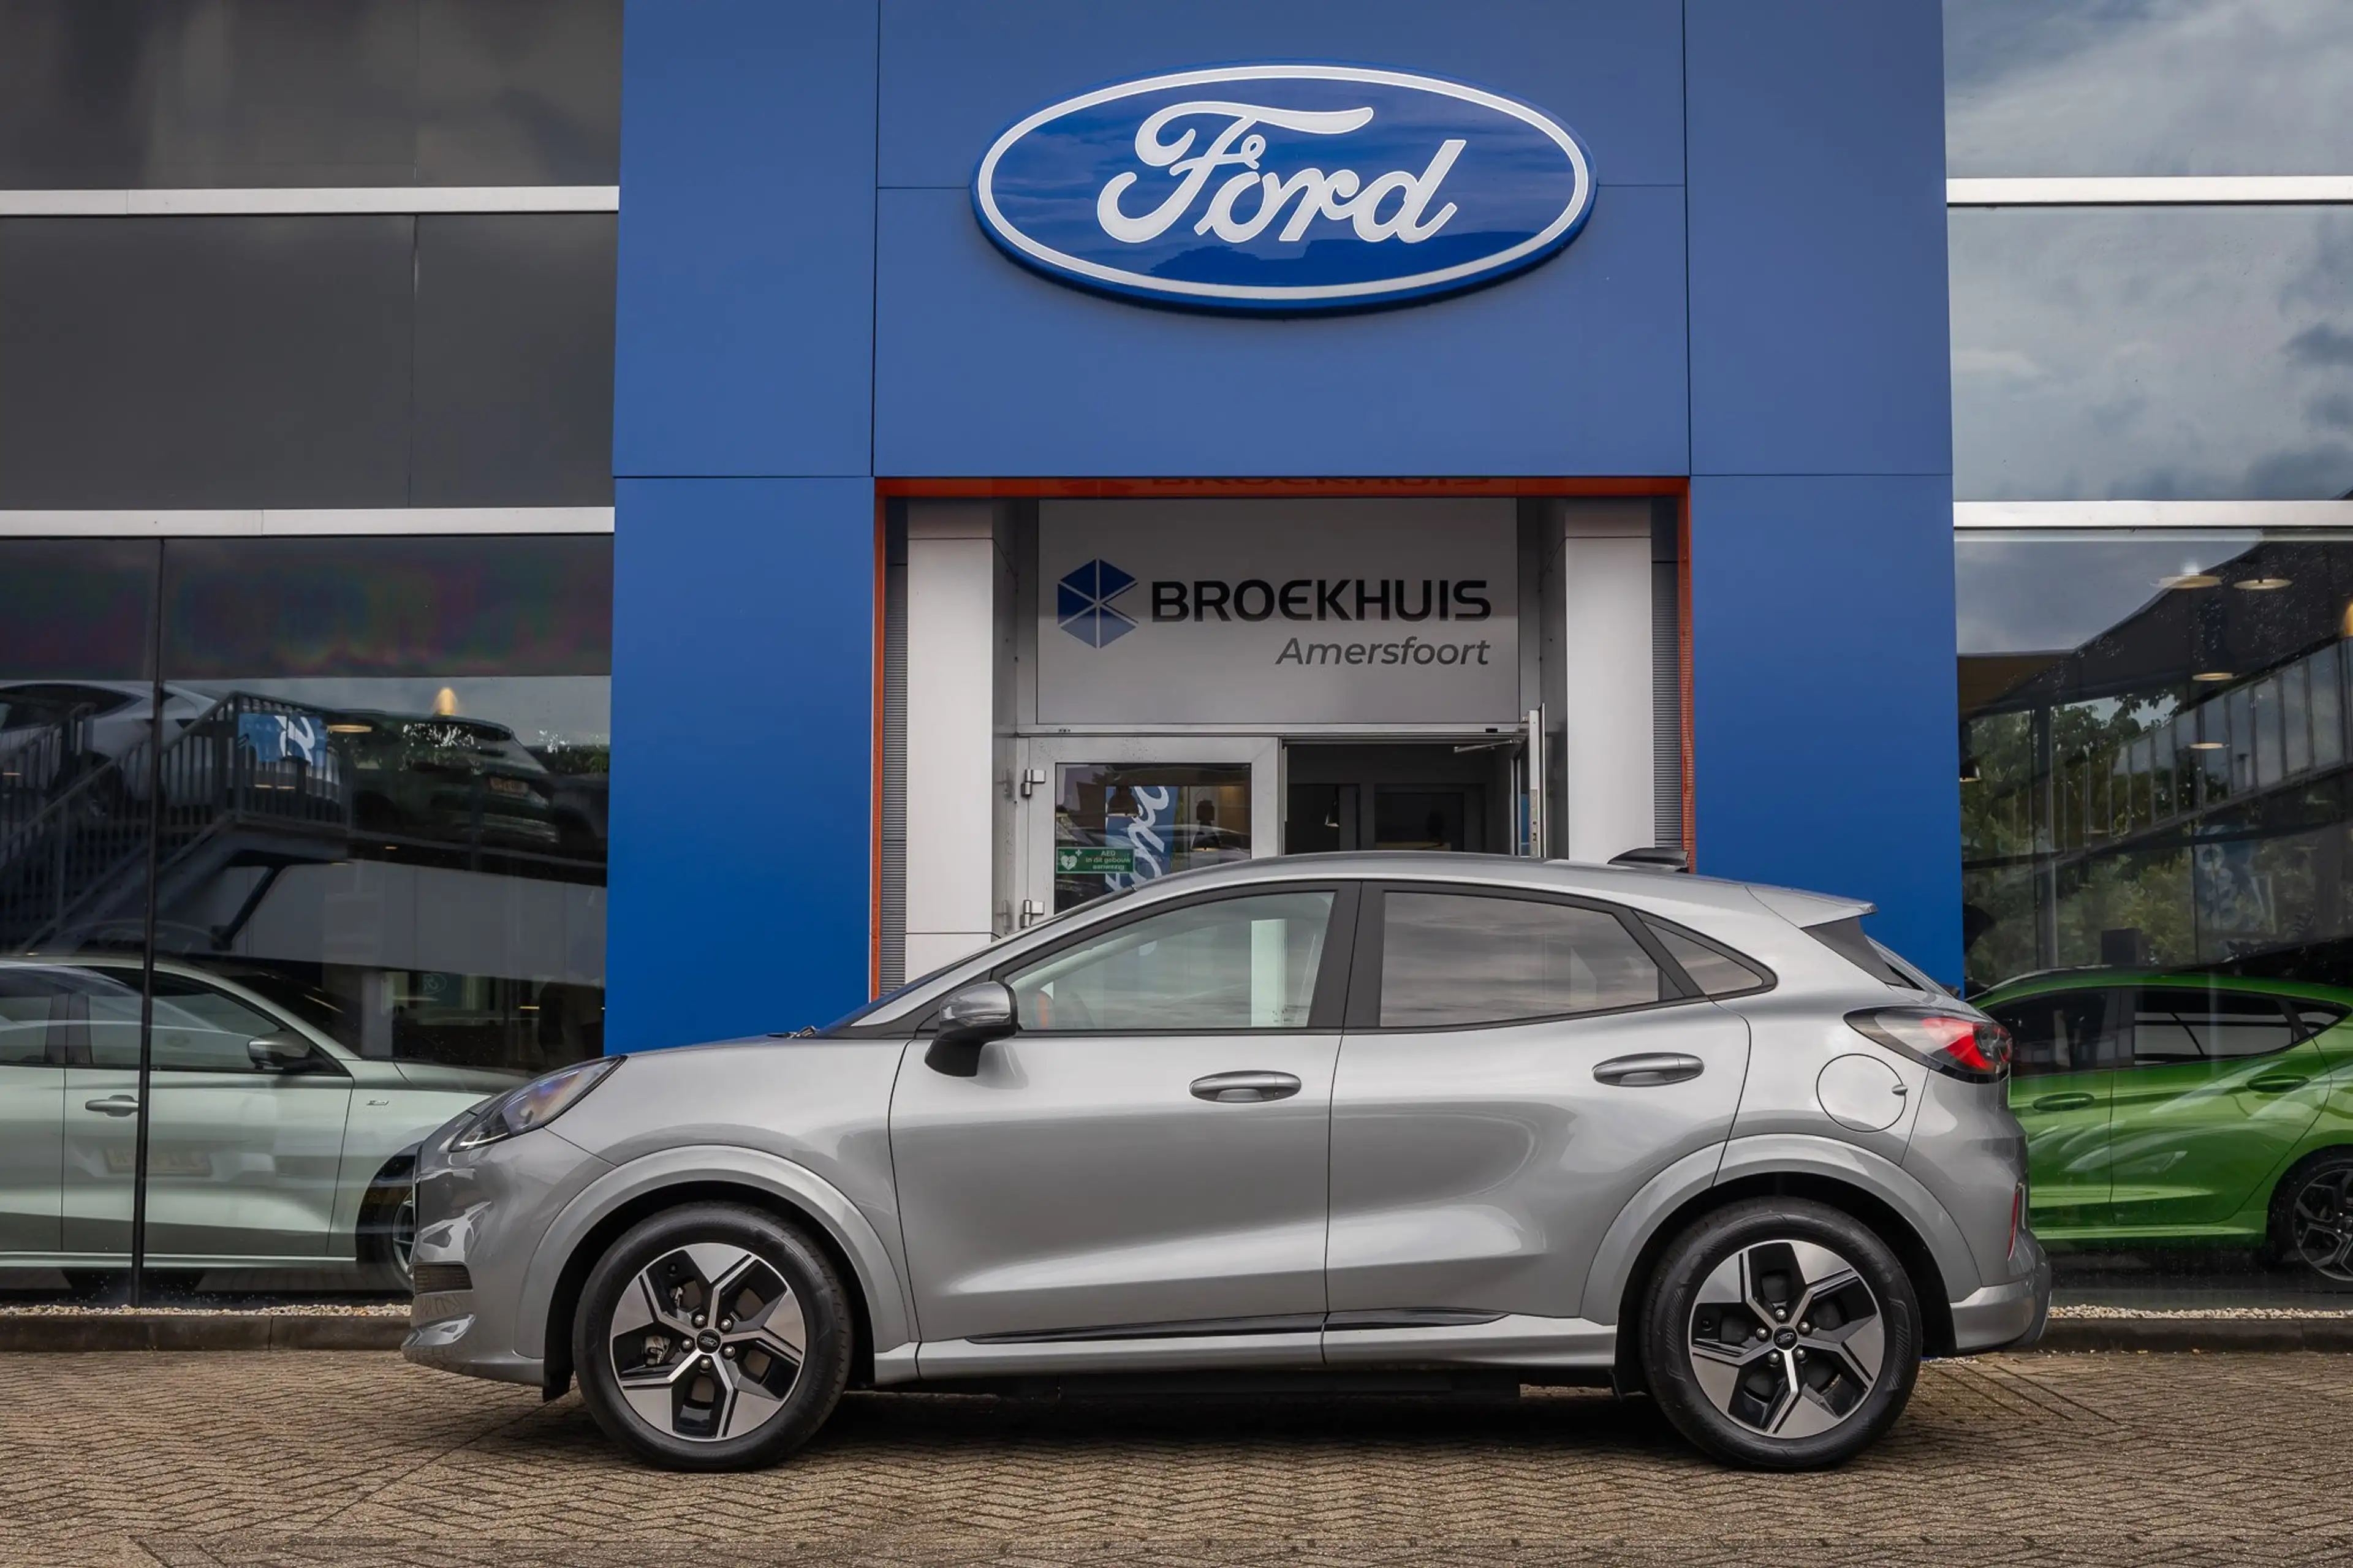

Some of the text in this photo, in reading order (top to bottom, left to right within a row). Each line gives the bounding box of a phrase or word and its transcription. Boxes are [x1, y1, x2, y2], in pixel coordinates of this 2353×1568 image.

[1097, 100, 1466, 243] Ford
[1151, 579, 1491, 622] BROEKHUIS
[1275, 635, 1491, 665] Amersfoort
